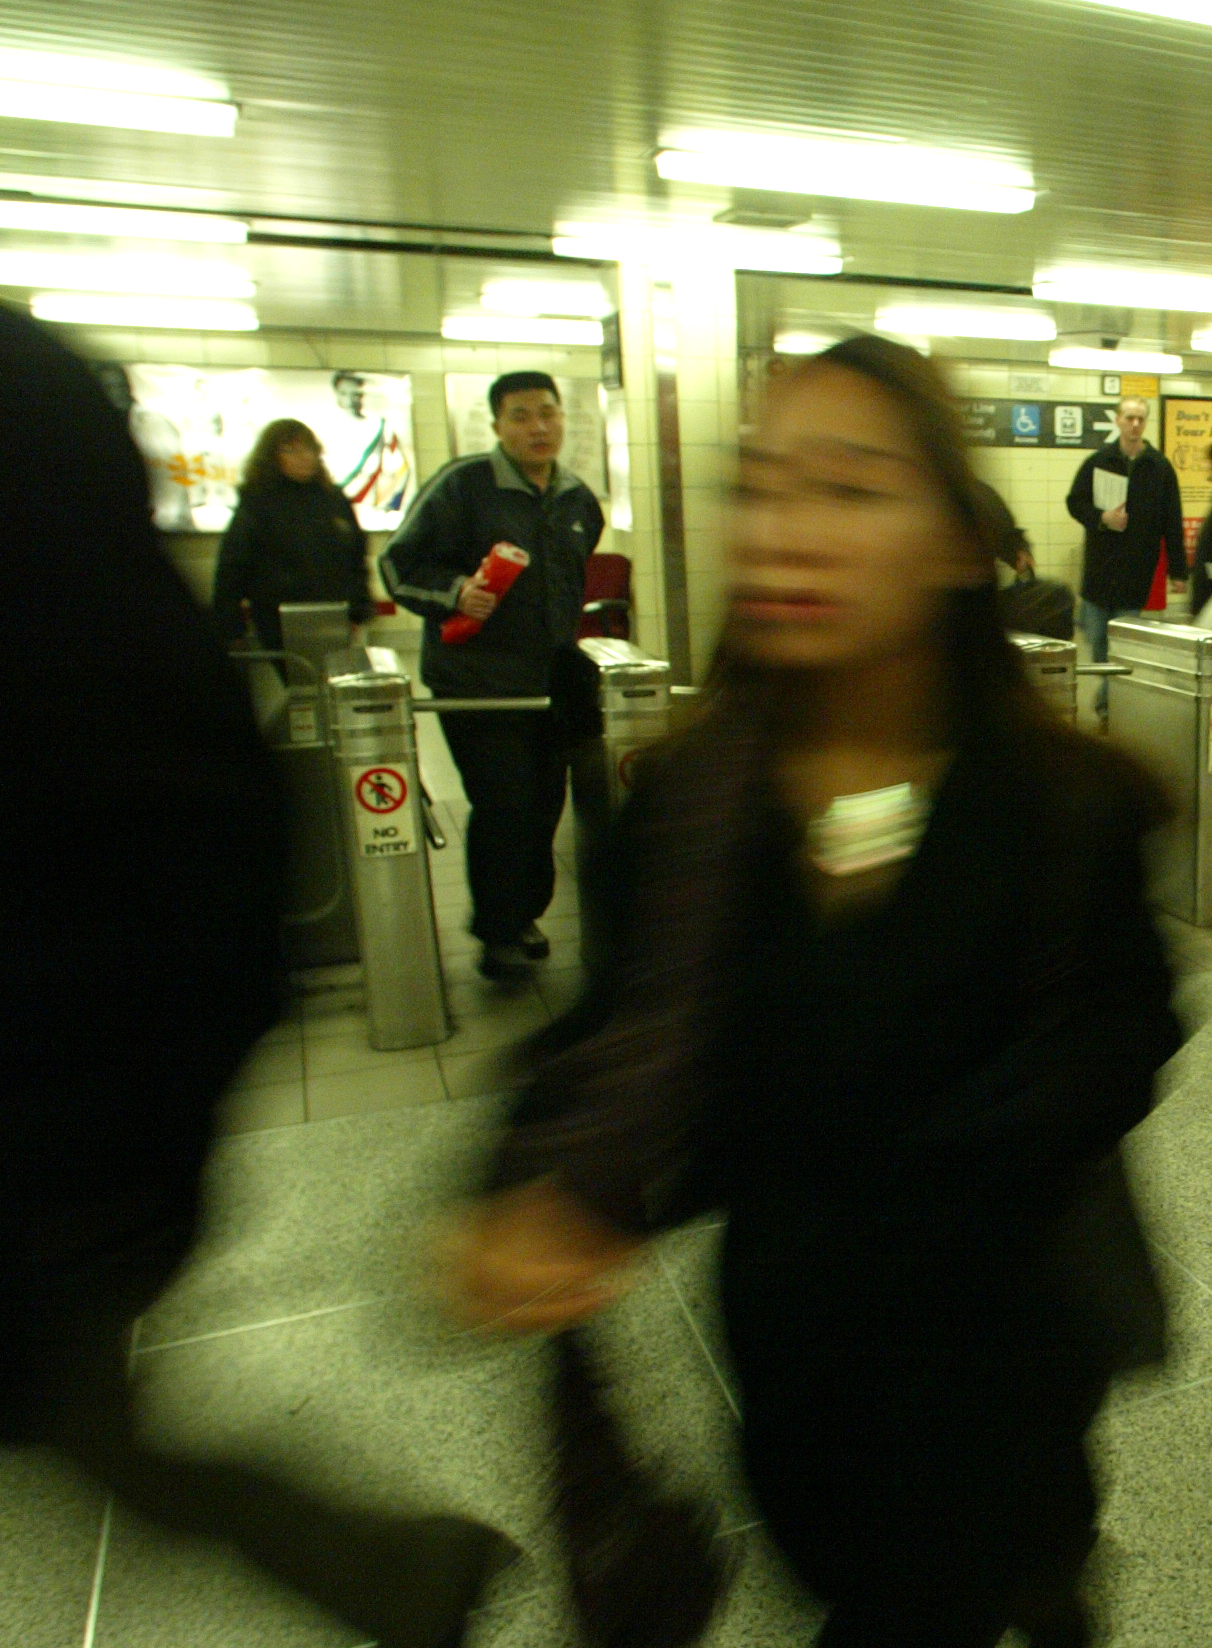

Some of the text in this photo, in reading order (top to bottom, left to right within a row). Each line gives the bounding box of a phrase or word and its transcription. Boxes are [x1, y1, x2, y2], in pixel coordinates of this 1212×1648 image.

[1176, 410, 1209, 422] Don't
[1176, 426, 1205, 437] Your
[373, 826, 398, 839] NO
[364, 841, 409, 854] ENTRY
